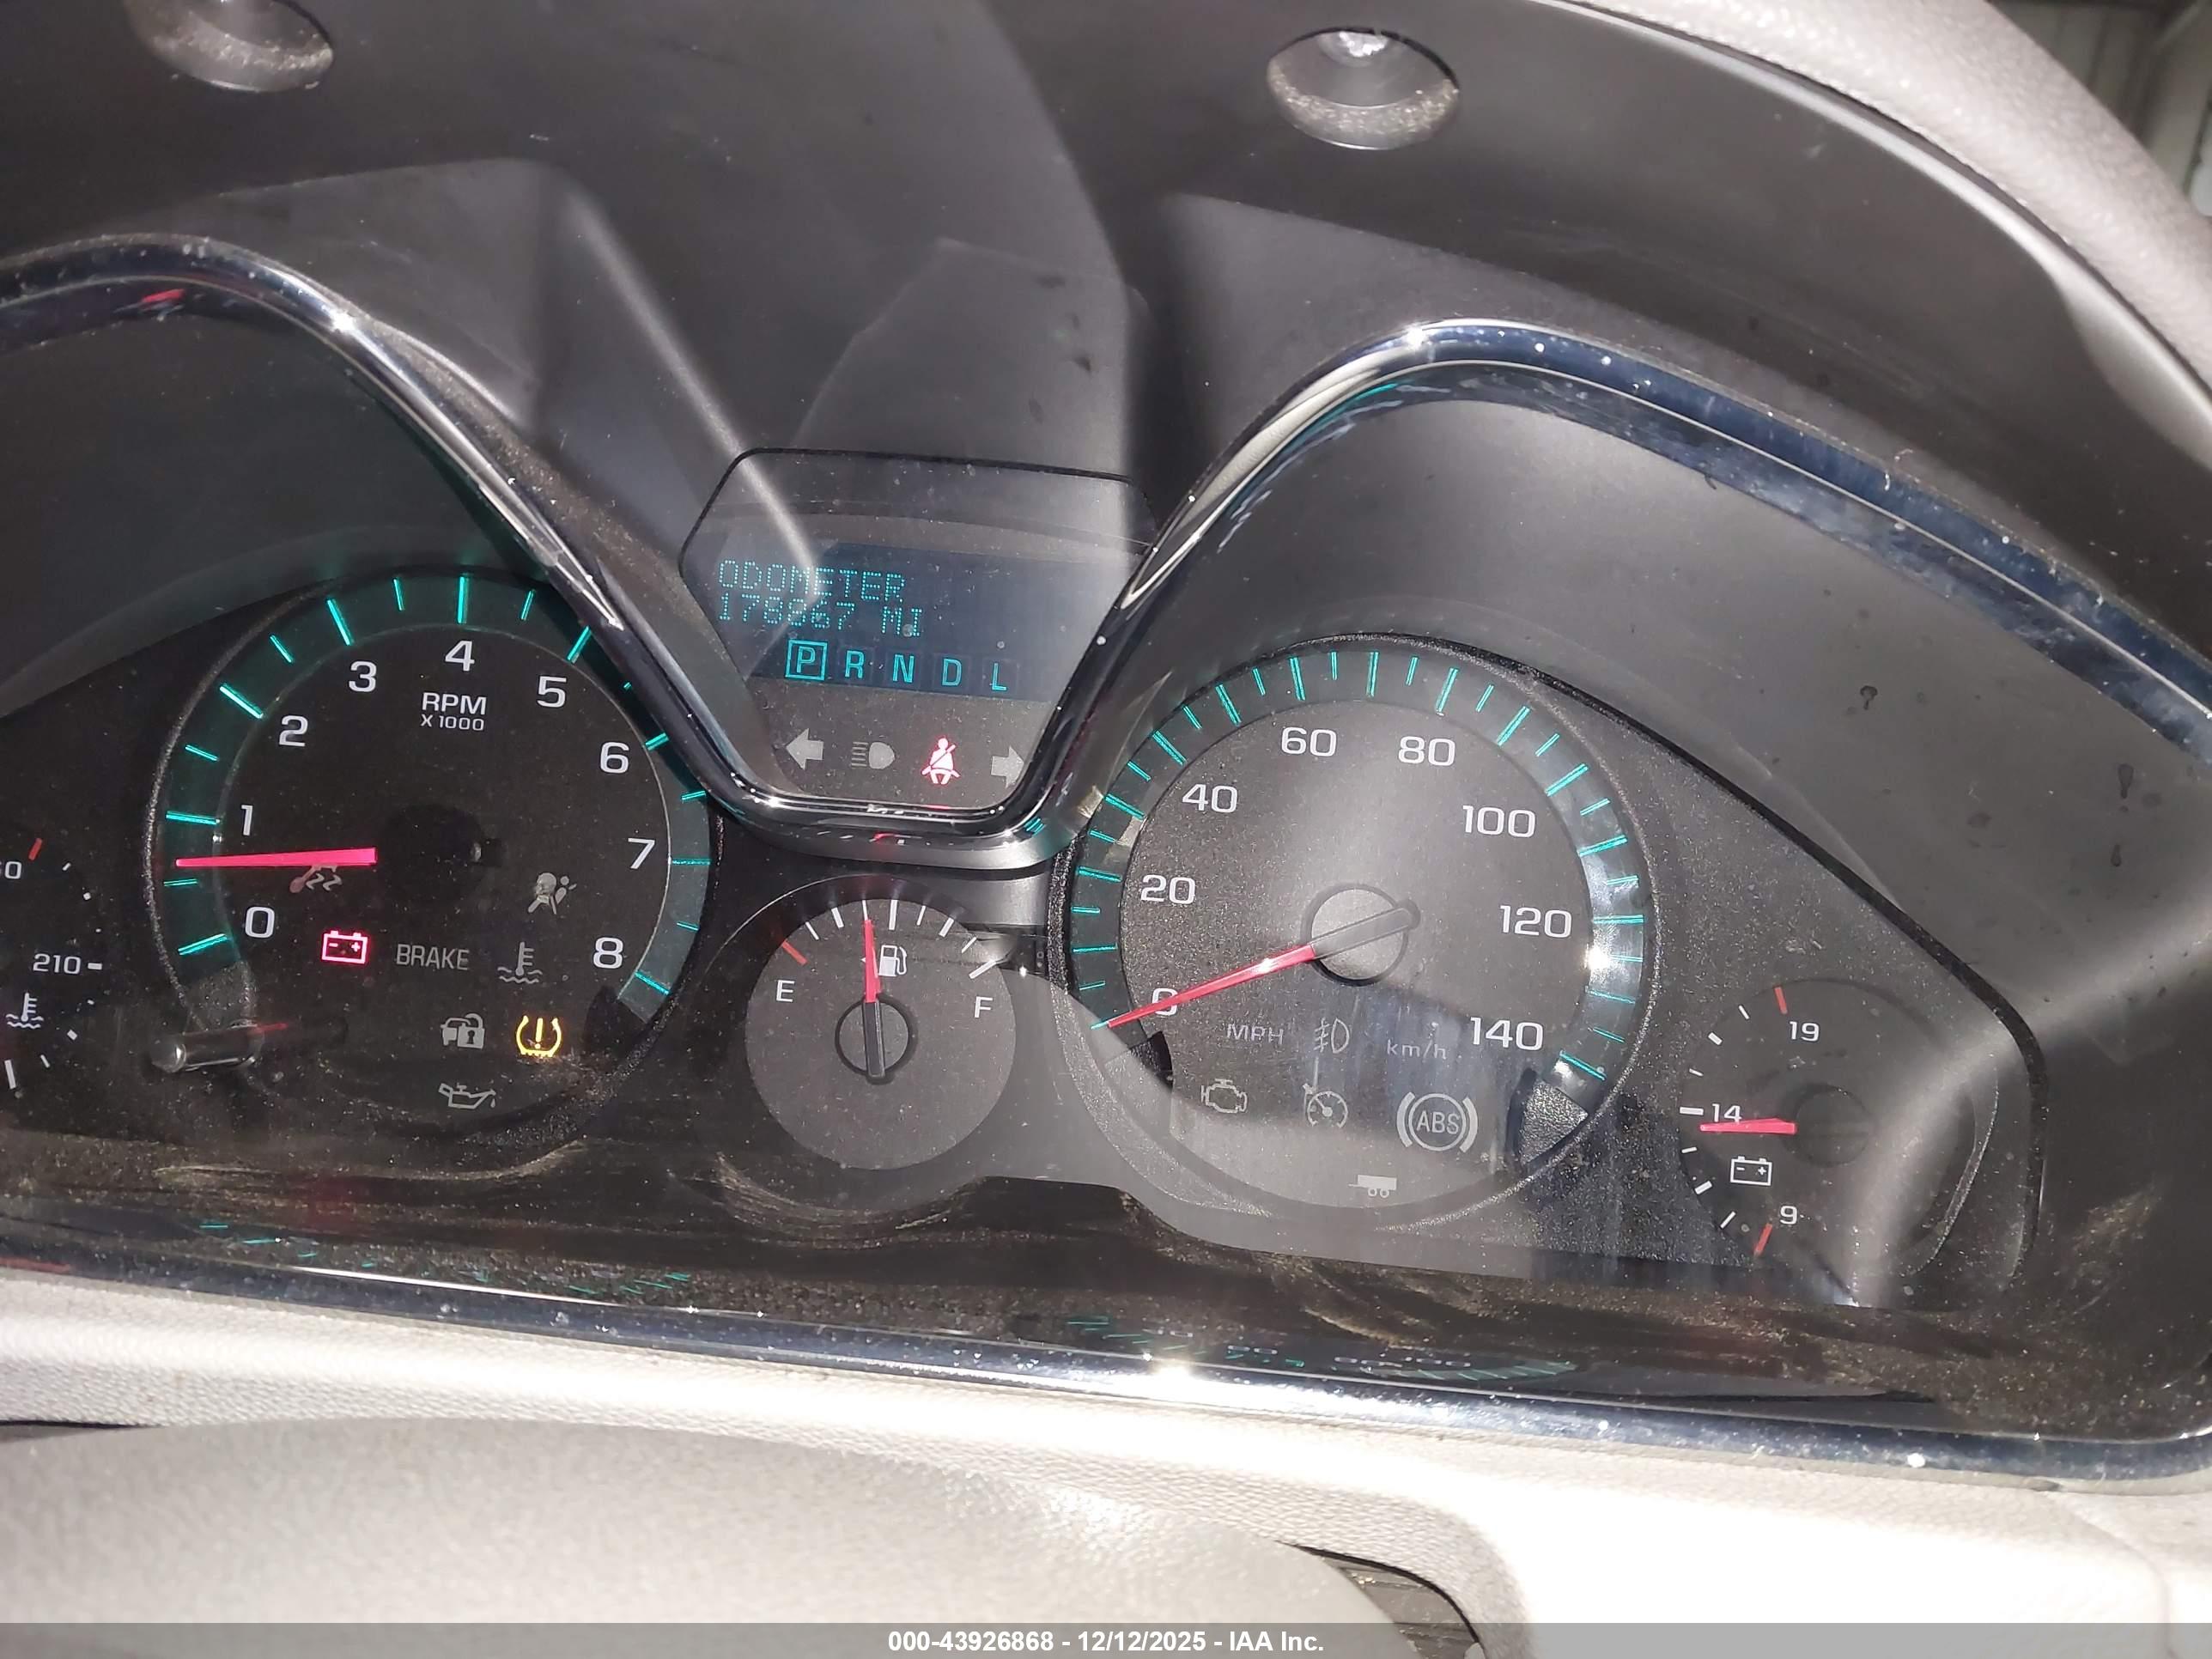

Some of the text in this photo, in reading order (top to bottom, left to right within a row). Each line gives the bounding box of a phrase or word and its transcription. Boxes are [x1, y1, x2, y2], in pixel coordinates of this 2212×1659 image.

[719, 559, 905, 602] ODOMETER
[719, 592, 921, 637] 178867 MI
[445, 640, 475, 672] 4
[796, 646, 1007, 690] P R N D L
[348, 660, 378, 693] 3
[535, 676, 568, 708] 5
[421, 692, 487, 716] RPM
[278, 715, 309, 747] 2
[438, 714, 485, 732] 1000
[1279, 726, 1338, 758] 60
[1398, 736, 1456, 767] 80
[600, 742, 629, 774] 6
[1182, 784, 1238, 814] 40
[240, 805, 253, 836] 1
[1464, 805, 1536, 838] 100
[627, 837, 656, 870] 7
[0, 860, 22, 880] 0
[1140, 874, 1196, 905] 20
[245, 906, 276, 939] 0
[1499, 905, 1572, 939] 120
[32, 953, 82, 975] 210
[396, 943, 471, 971] BRAKE
[592, 937, 623, 969] 8
[775, 980, 795, 1002] E
[1152, 988, 1178, 1017] 0
[974, 996, 994, 1018] F
[1226, 1022, 1285, 1045] MPH
[1469, 1016, 1544, 1051] 140
[1790, 1020, 1820, 1042] 19
[1386, 1038, 1447, 1060] km/h
[1415, 1111, 1460, 1134] ABS
[1711, 1103, 1741, 1123] 14
[1779, 1205, 1798, 1225] 9
